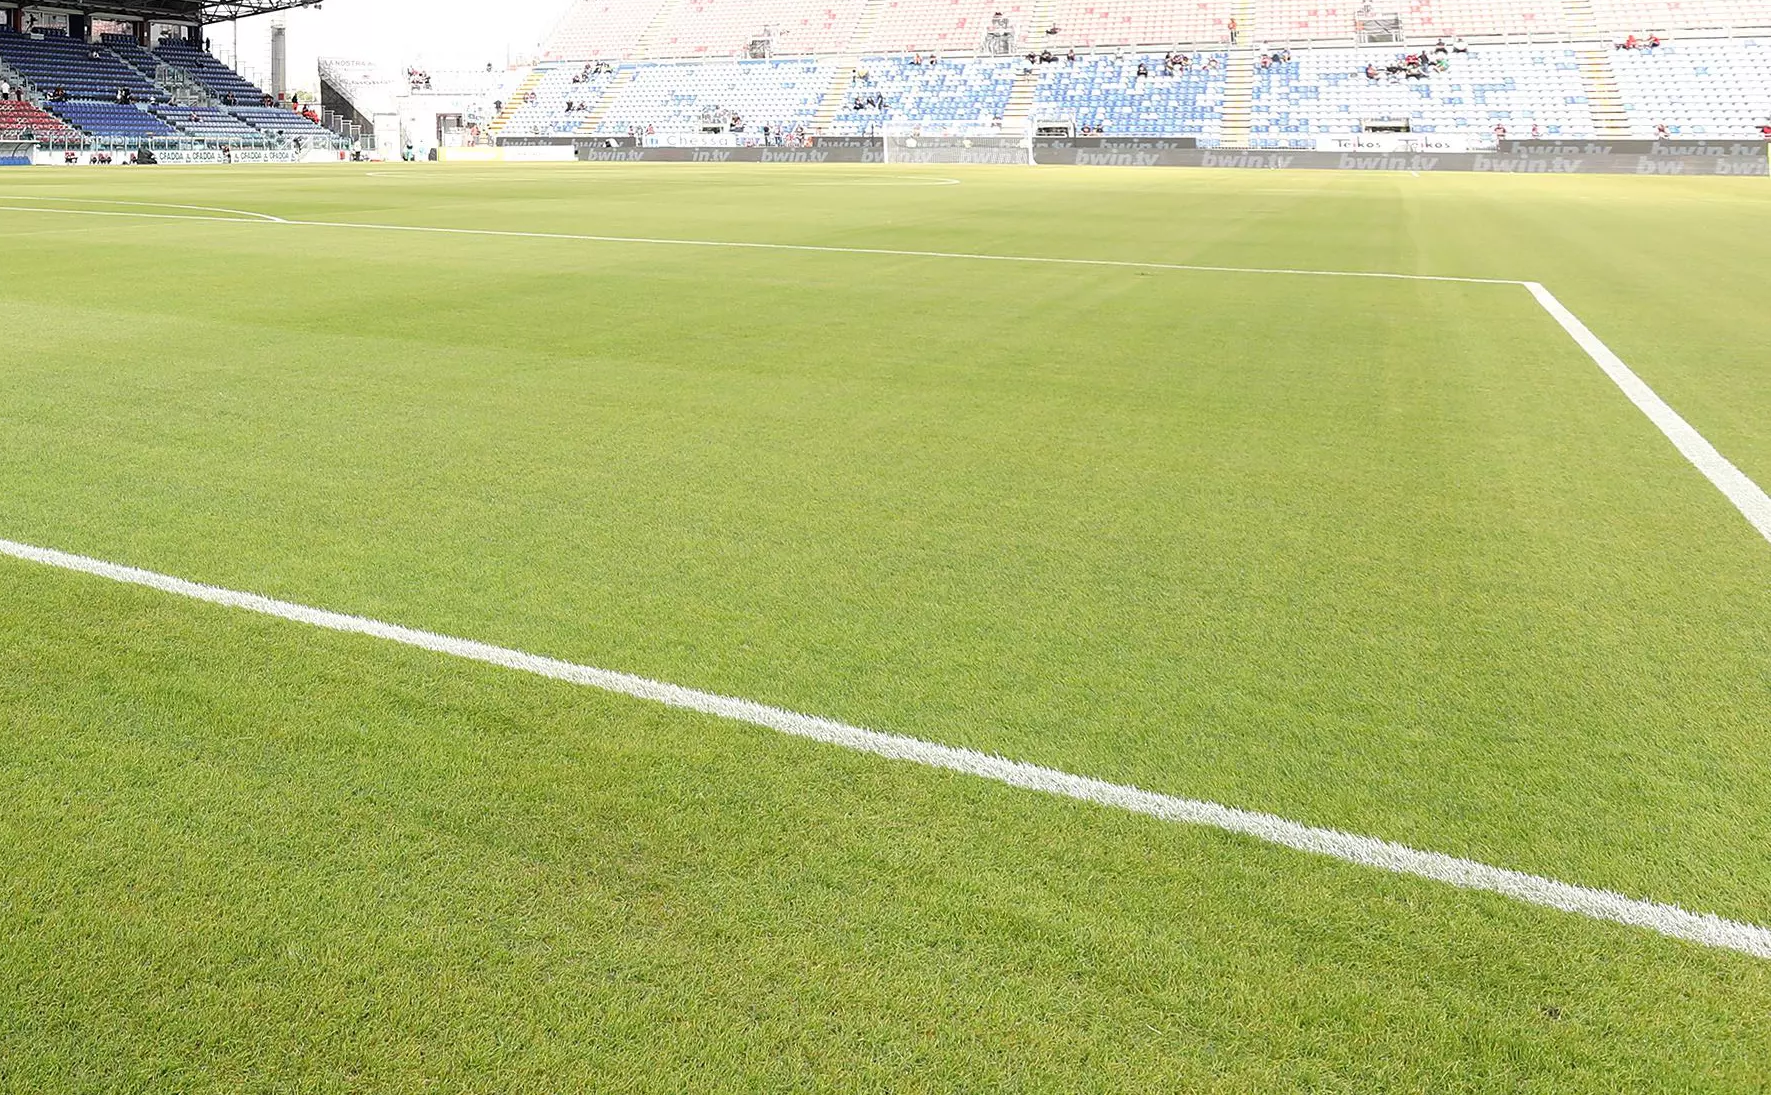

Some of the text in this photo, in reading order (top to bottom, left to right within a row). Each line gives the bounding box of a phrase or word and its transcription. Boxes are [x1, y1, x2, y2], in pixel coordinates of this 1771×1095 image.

[666, 133, 728, 146] Chessa
[1331, 135, 1381, 150] Teikos
[588, 148, 644, 162] bwin.tv
[761, 148, 828, 162] bwin.tv
[1075, 149, 1159, 165] bwin.tv
[1201, 151, 1294, 168] bwin.tv
[1338, 153, 1438, 171] bwin.tv
[1473, 154, 1582, 173] bwin.tv
